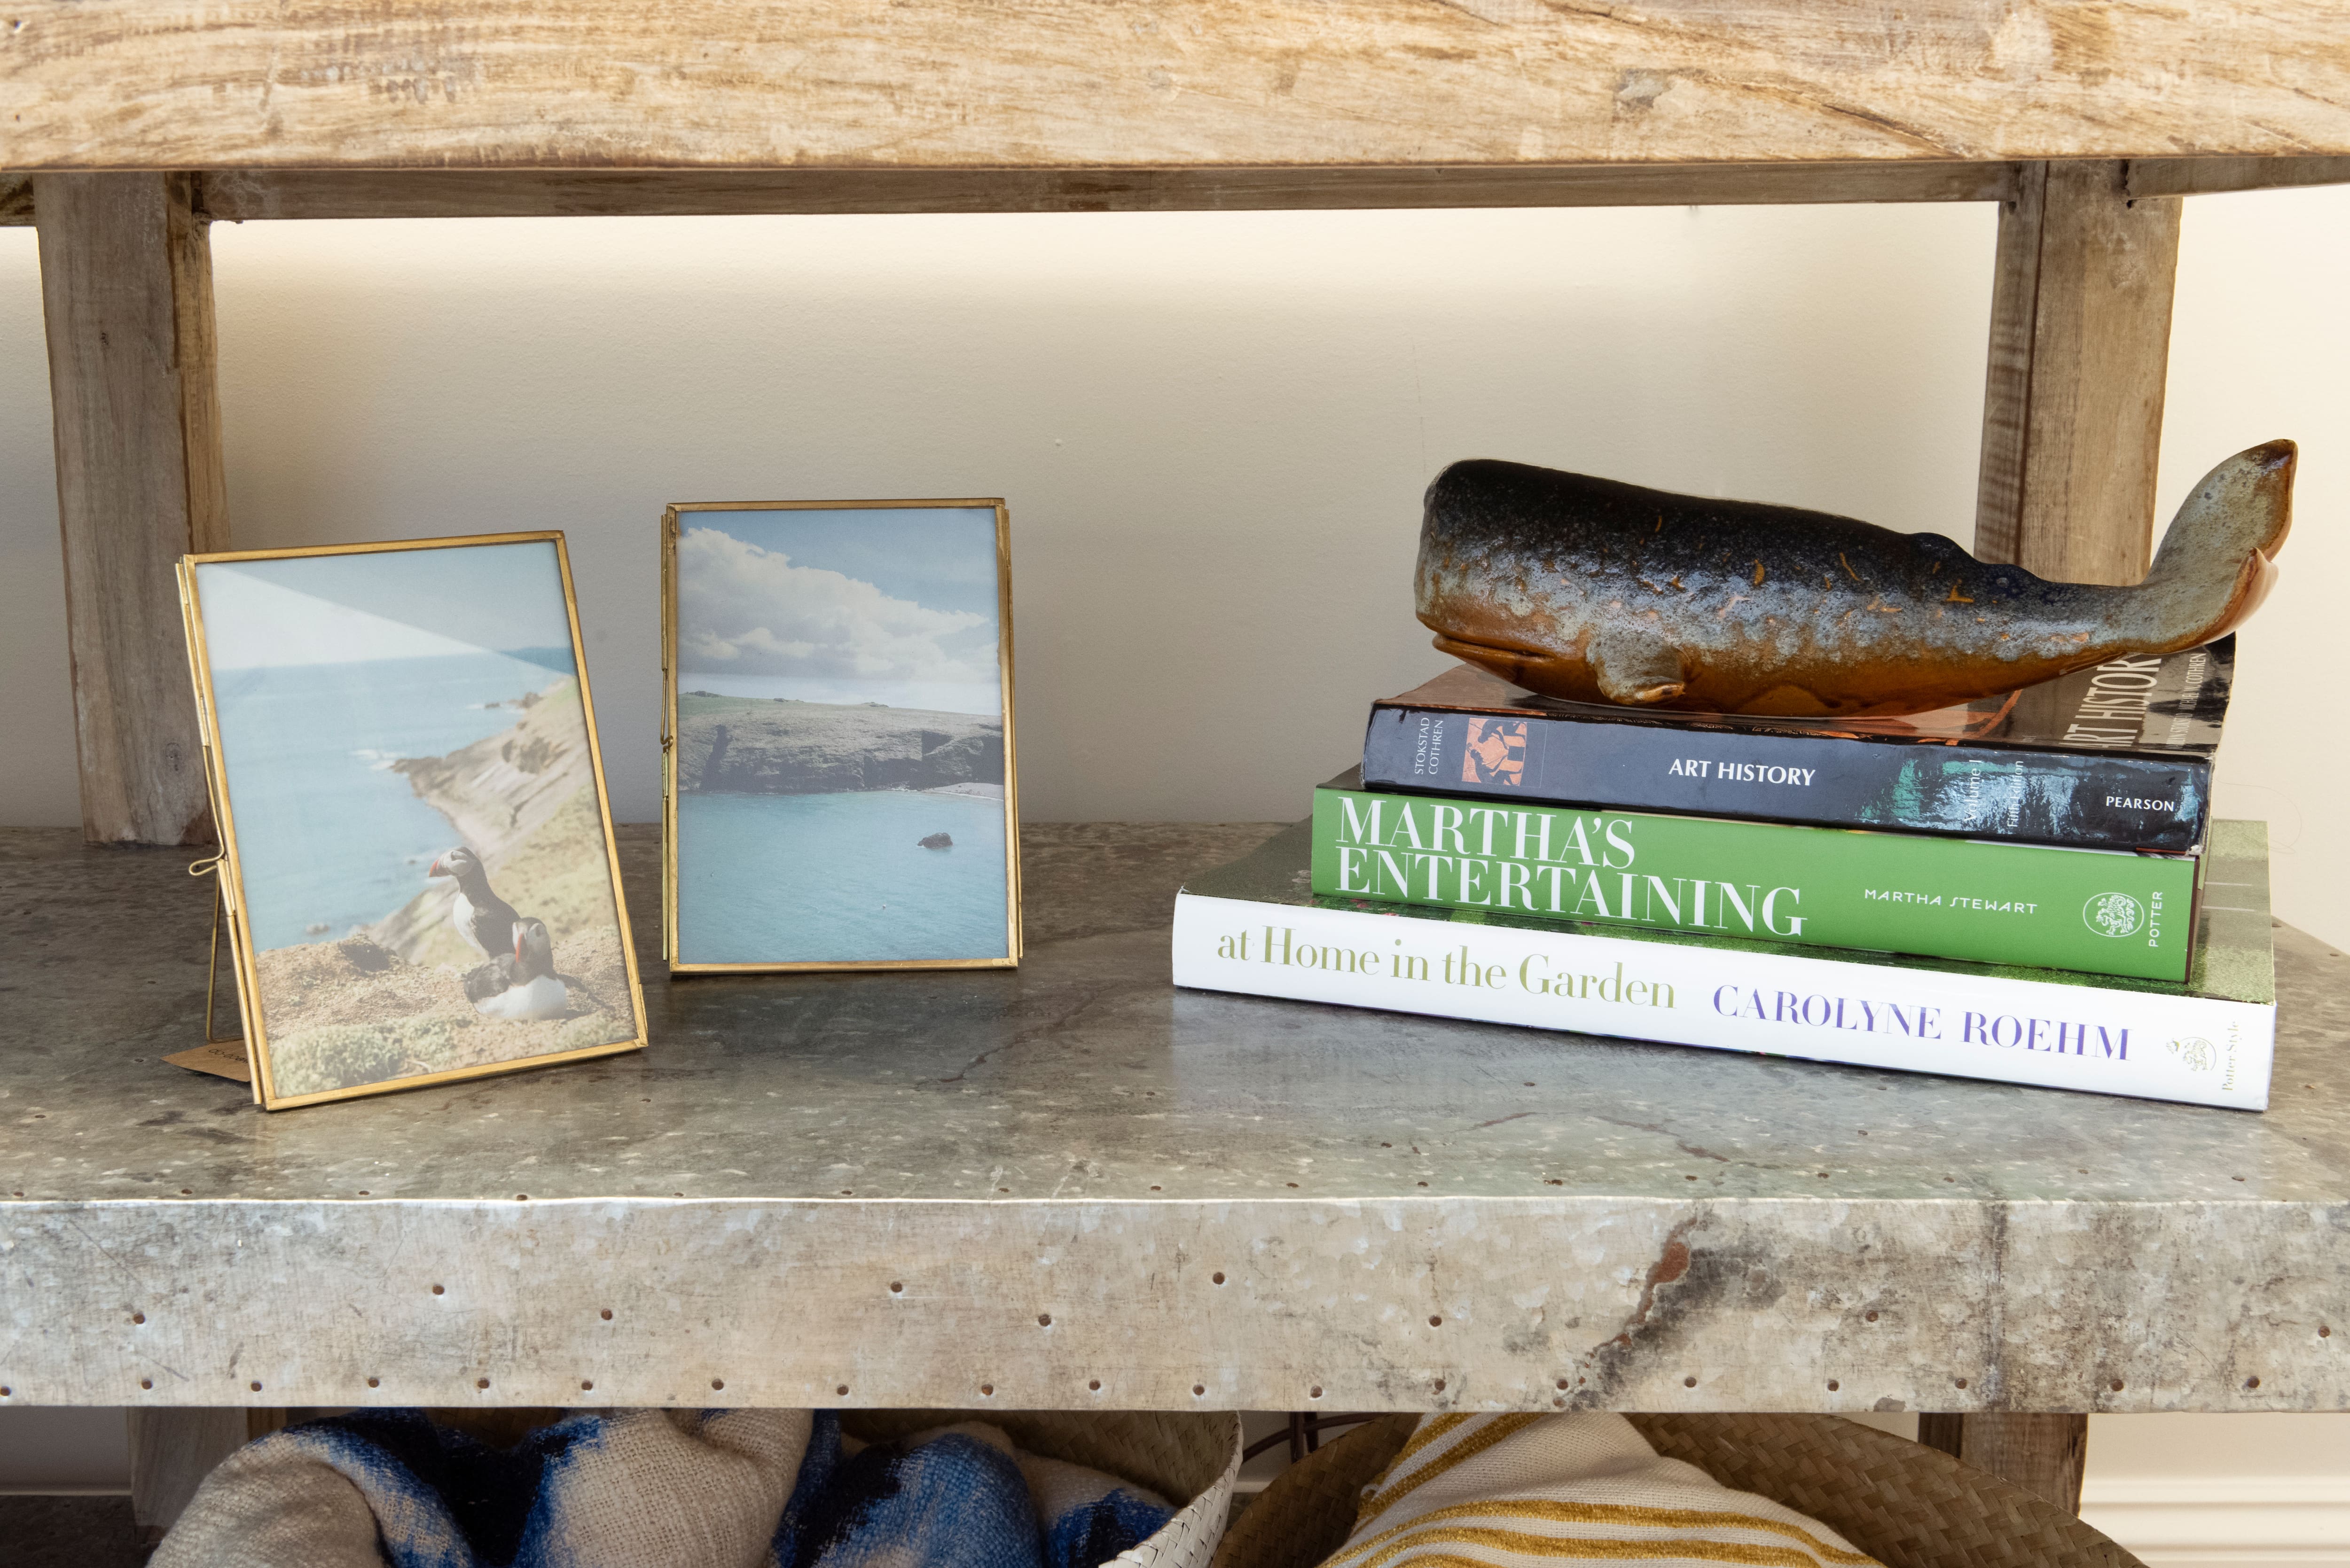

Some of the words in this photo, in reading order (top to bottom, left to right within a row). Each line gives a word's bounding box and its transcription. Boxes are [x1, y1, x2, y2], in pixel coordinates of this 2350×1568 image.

[2075, 658, 2162, 721] HISTOR
[2185, 653, 2207, 684] COTHREN
[1414, 717, 1430, 775] STOKSTAD
[1428, 719, 1444, 775] COTHREN
[1668, 758, 1712, 778] ART
[1718, 762, 1816, 786] HISTORY
[1963, 767, 1982, 822] Volume
[2010, 760, 2024, 798] Edition
[2006, 803, 2020, 827] Fifth
[2106, 796, 2175, 812] PEARSON
[1335, 846, 1808, 937] ENTERTAINING
[1864, 889, 1942, 906] MARTHA
[1950, 897, 2038, 914] STEWART
[2148, 891, 2163, 947] POTTER
[1217, 929, 1251, 961] at
[1260, 925, 1380, 975] Home
[1390, 938, 1431, 982] in
[1441, 944, 1507, 991] the
[1519, 953, 1677, 1008] Garden
[1713, 985, 1942, 1040] CAROLYNE
[1960, 1011, 2133, 1061] ROEHM
[2226, 1021, 2242, 1053] Style
[2222, 1055, 2236, 1091] Potter
